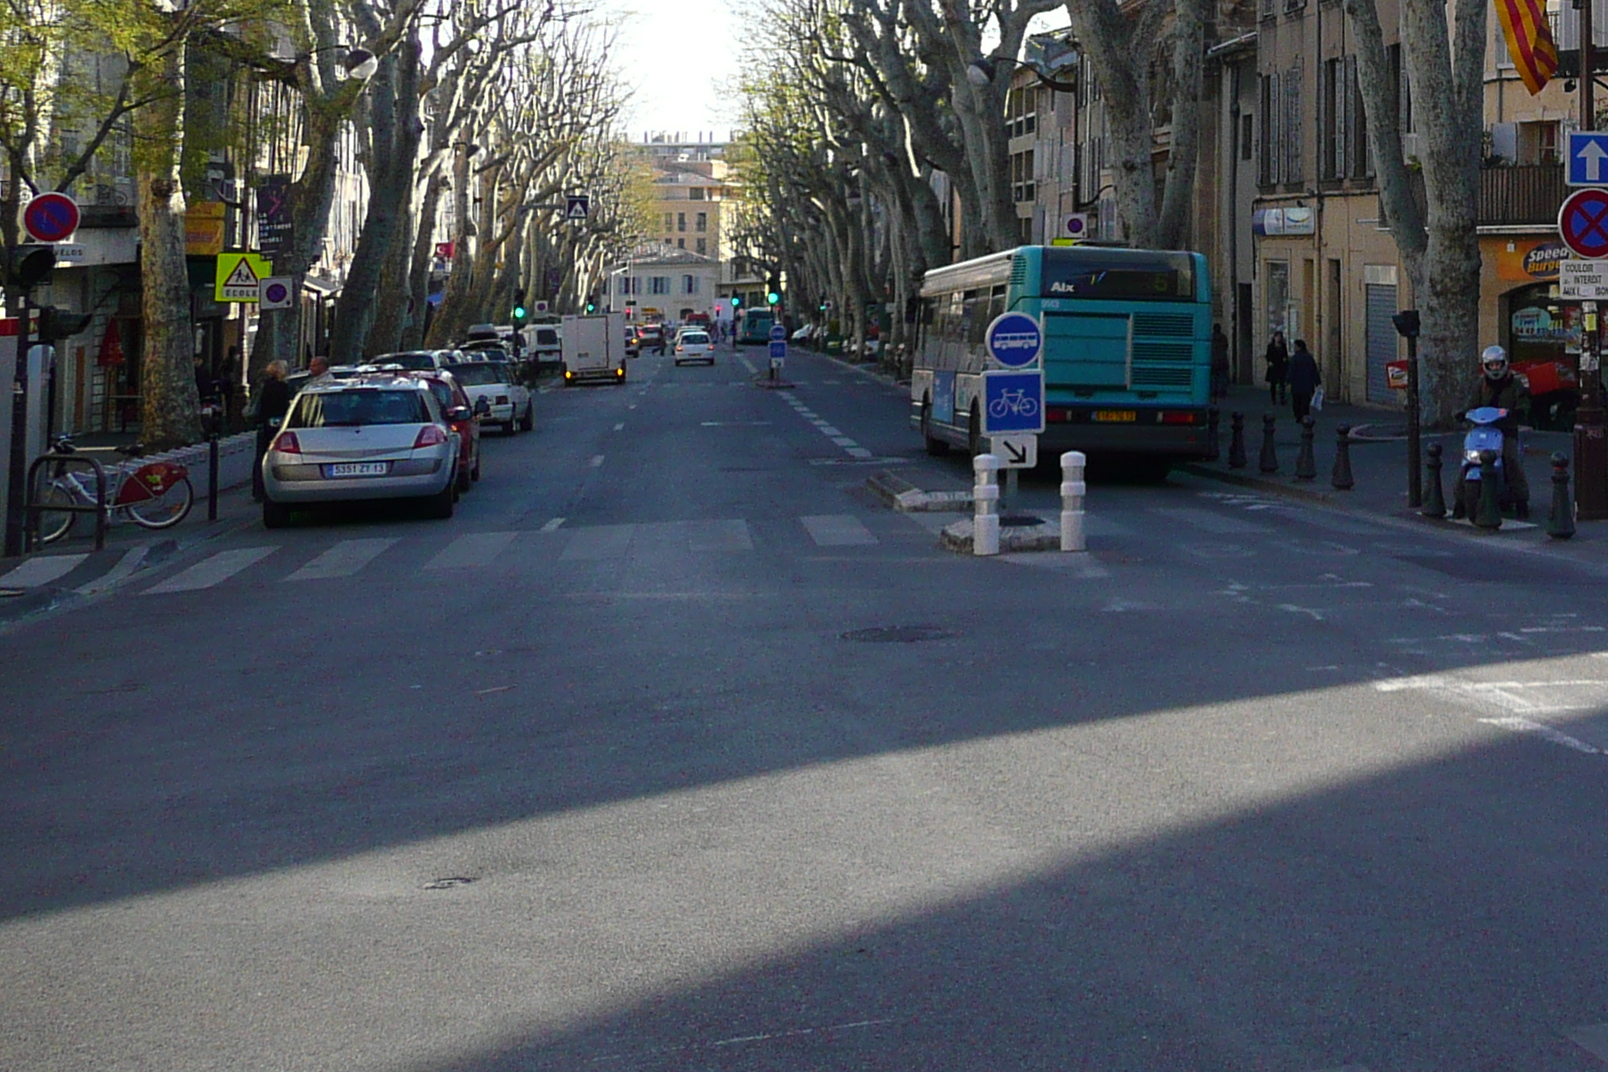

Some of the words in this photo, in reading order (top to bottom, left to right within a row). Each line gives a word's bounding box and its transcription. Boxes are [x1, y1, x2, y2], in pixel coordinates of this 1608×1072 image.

[1528, 247, 1568, 262] Speed
[1565, 263, 1594, 273] COULOIR
[1574, 274, 1602, 284] INTERDIT
[1563, 286, 1576, 296] AUX
